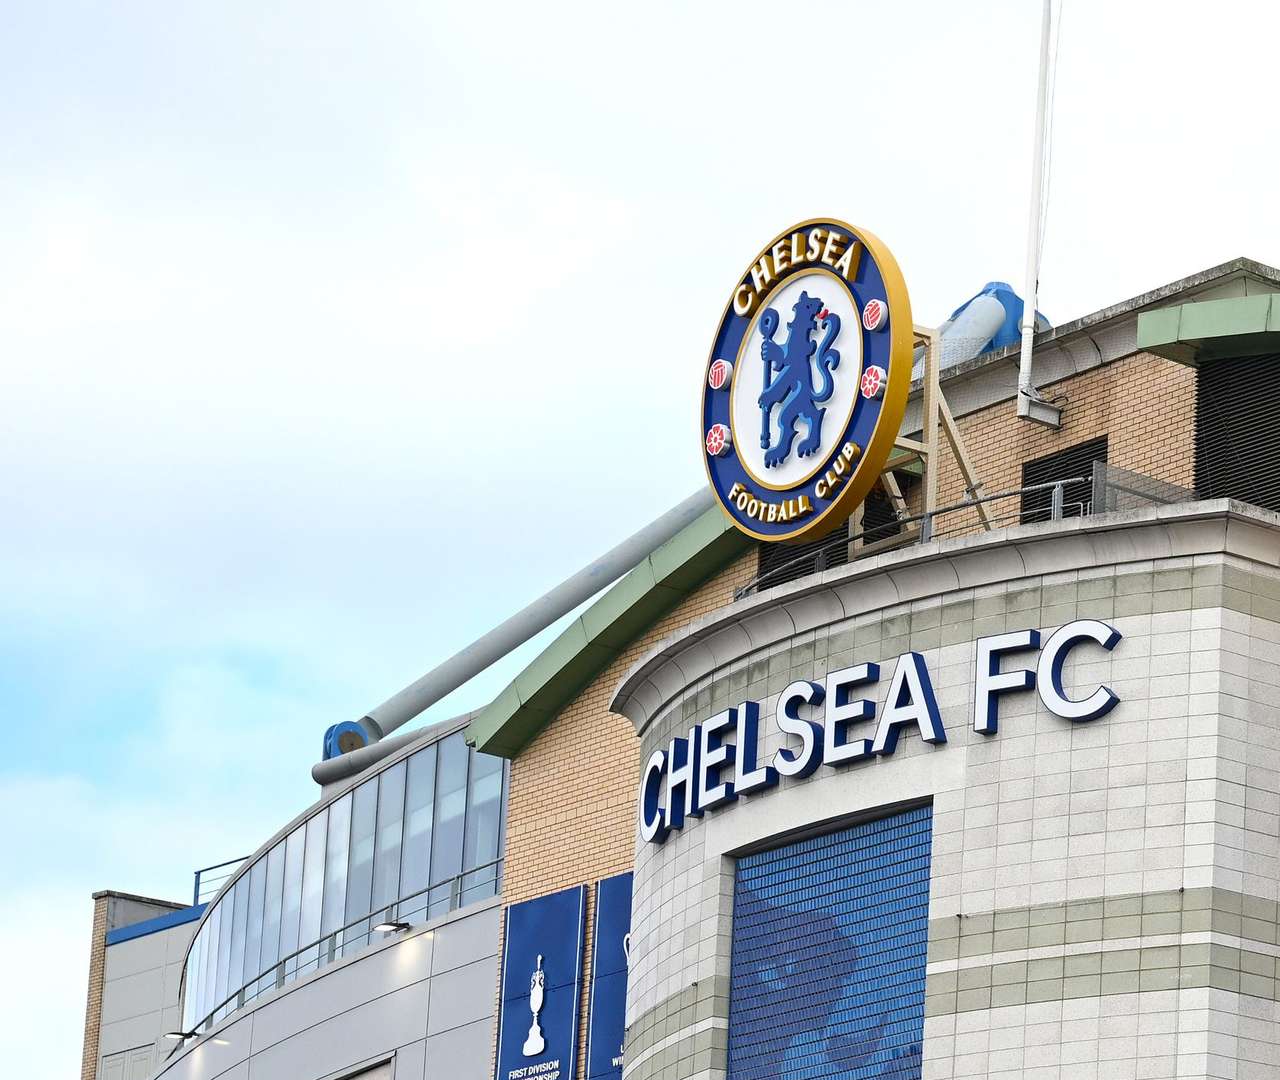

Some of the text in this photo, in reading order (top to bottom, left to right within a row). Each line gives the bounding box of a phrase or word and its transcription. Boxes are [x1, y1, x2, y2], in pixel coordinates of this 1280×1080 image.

[733, 225, 859, 318] CHELSEA
[727, 441, 860, 524] FOOTBALL CLUB
[638, 618, 1123, 845] CHELSEA FC
[509, 1060, 559, 1080] FIRST DIVISION
